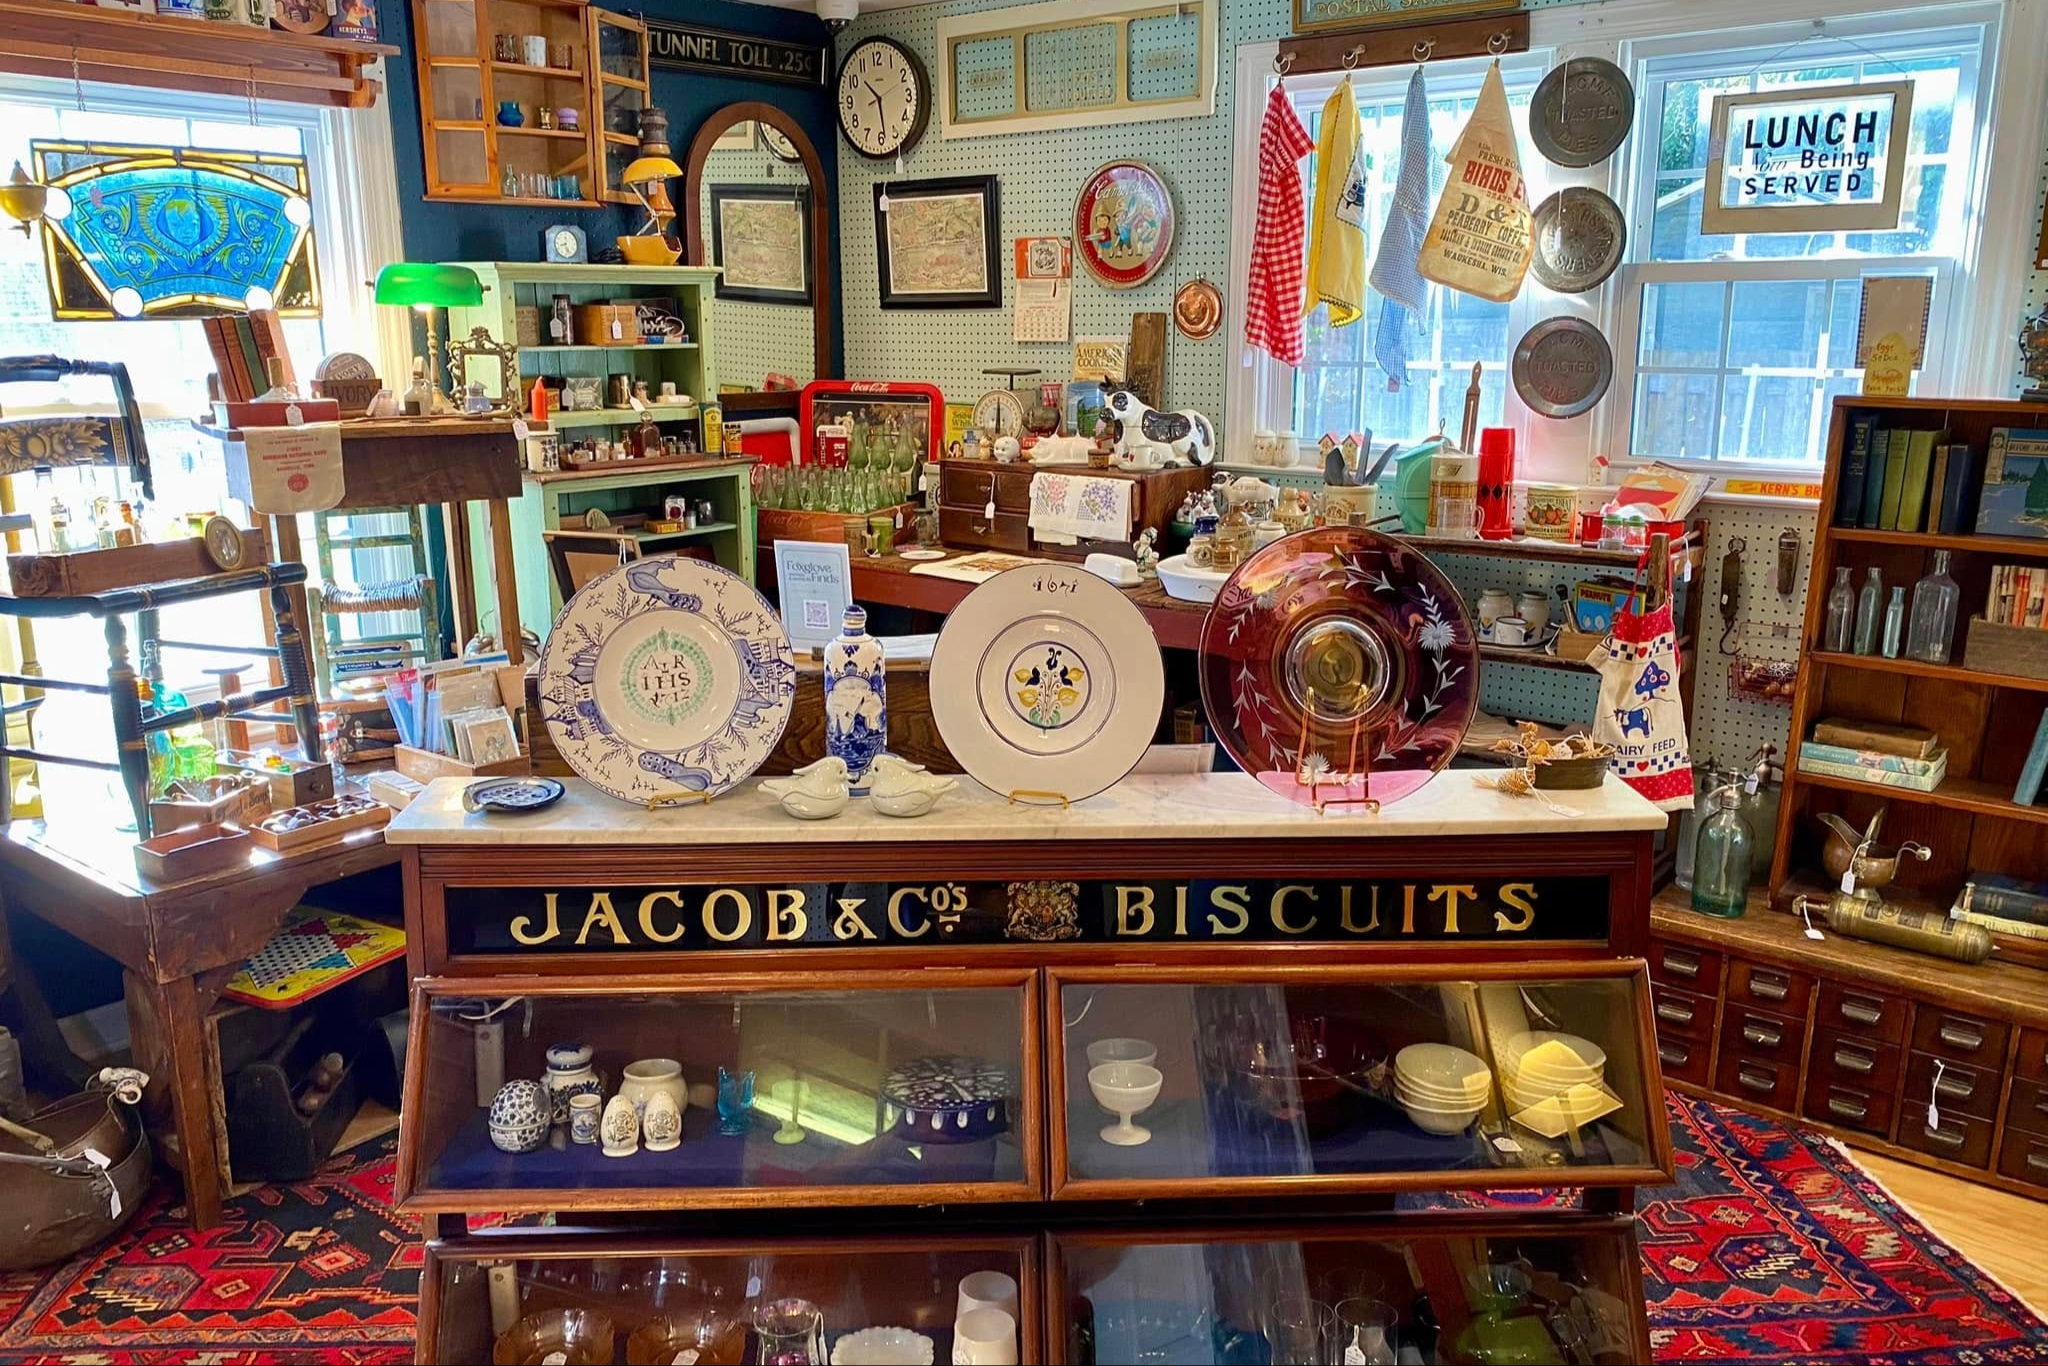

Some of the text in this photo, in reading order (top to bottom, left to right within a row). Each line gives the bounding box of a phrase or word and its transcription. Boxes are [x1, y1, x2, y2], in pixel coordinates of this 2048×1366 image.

[1316, 0, 1391, 16] POSTAL
[649, 31, 720, 61] TUNNEL
[729, 42, 772, 68] TOLL
[860, 58, 866, 73] 11
[872, 52, 882, 67] 12
[849, 74, 859, 89] 10
[900, 68, 907, 83] 2
[846, 95, 853, 109] 9
[905, 88, 912, 103] 3
[852, 114, 859, 128] 8
[864, 128, 871, 142] 7
[1745, 111, 1877, 149] LUNCH
[878, 132, 886, 146] 6
[1478, 150, 1503, 165] FRESH
[1801, 149, 1869, 171] Being
[1462, 160, 1512, 194] BIRDS
[1745, 174, 1861, 195] SERVED
[1456, 192, 1480, 215] D
[1485, 203, 1509, 223] &
[1446, 210, 1492, 236] PEABERRY
[331, 386, 378, 403] IVORY
[1760, 482, 1799, 496] KERN'S
[786, 561, 832, 574] Foxglove
[811, 573, 840, 584] Finds
[1653, 738, 1676, 753] FEED
[510, 889, 806, 945] JACOB
[833, 898, 877, 941] &
[1115, 883, 1538, 936] BISCUITS
